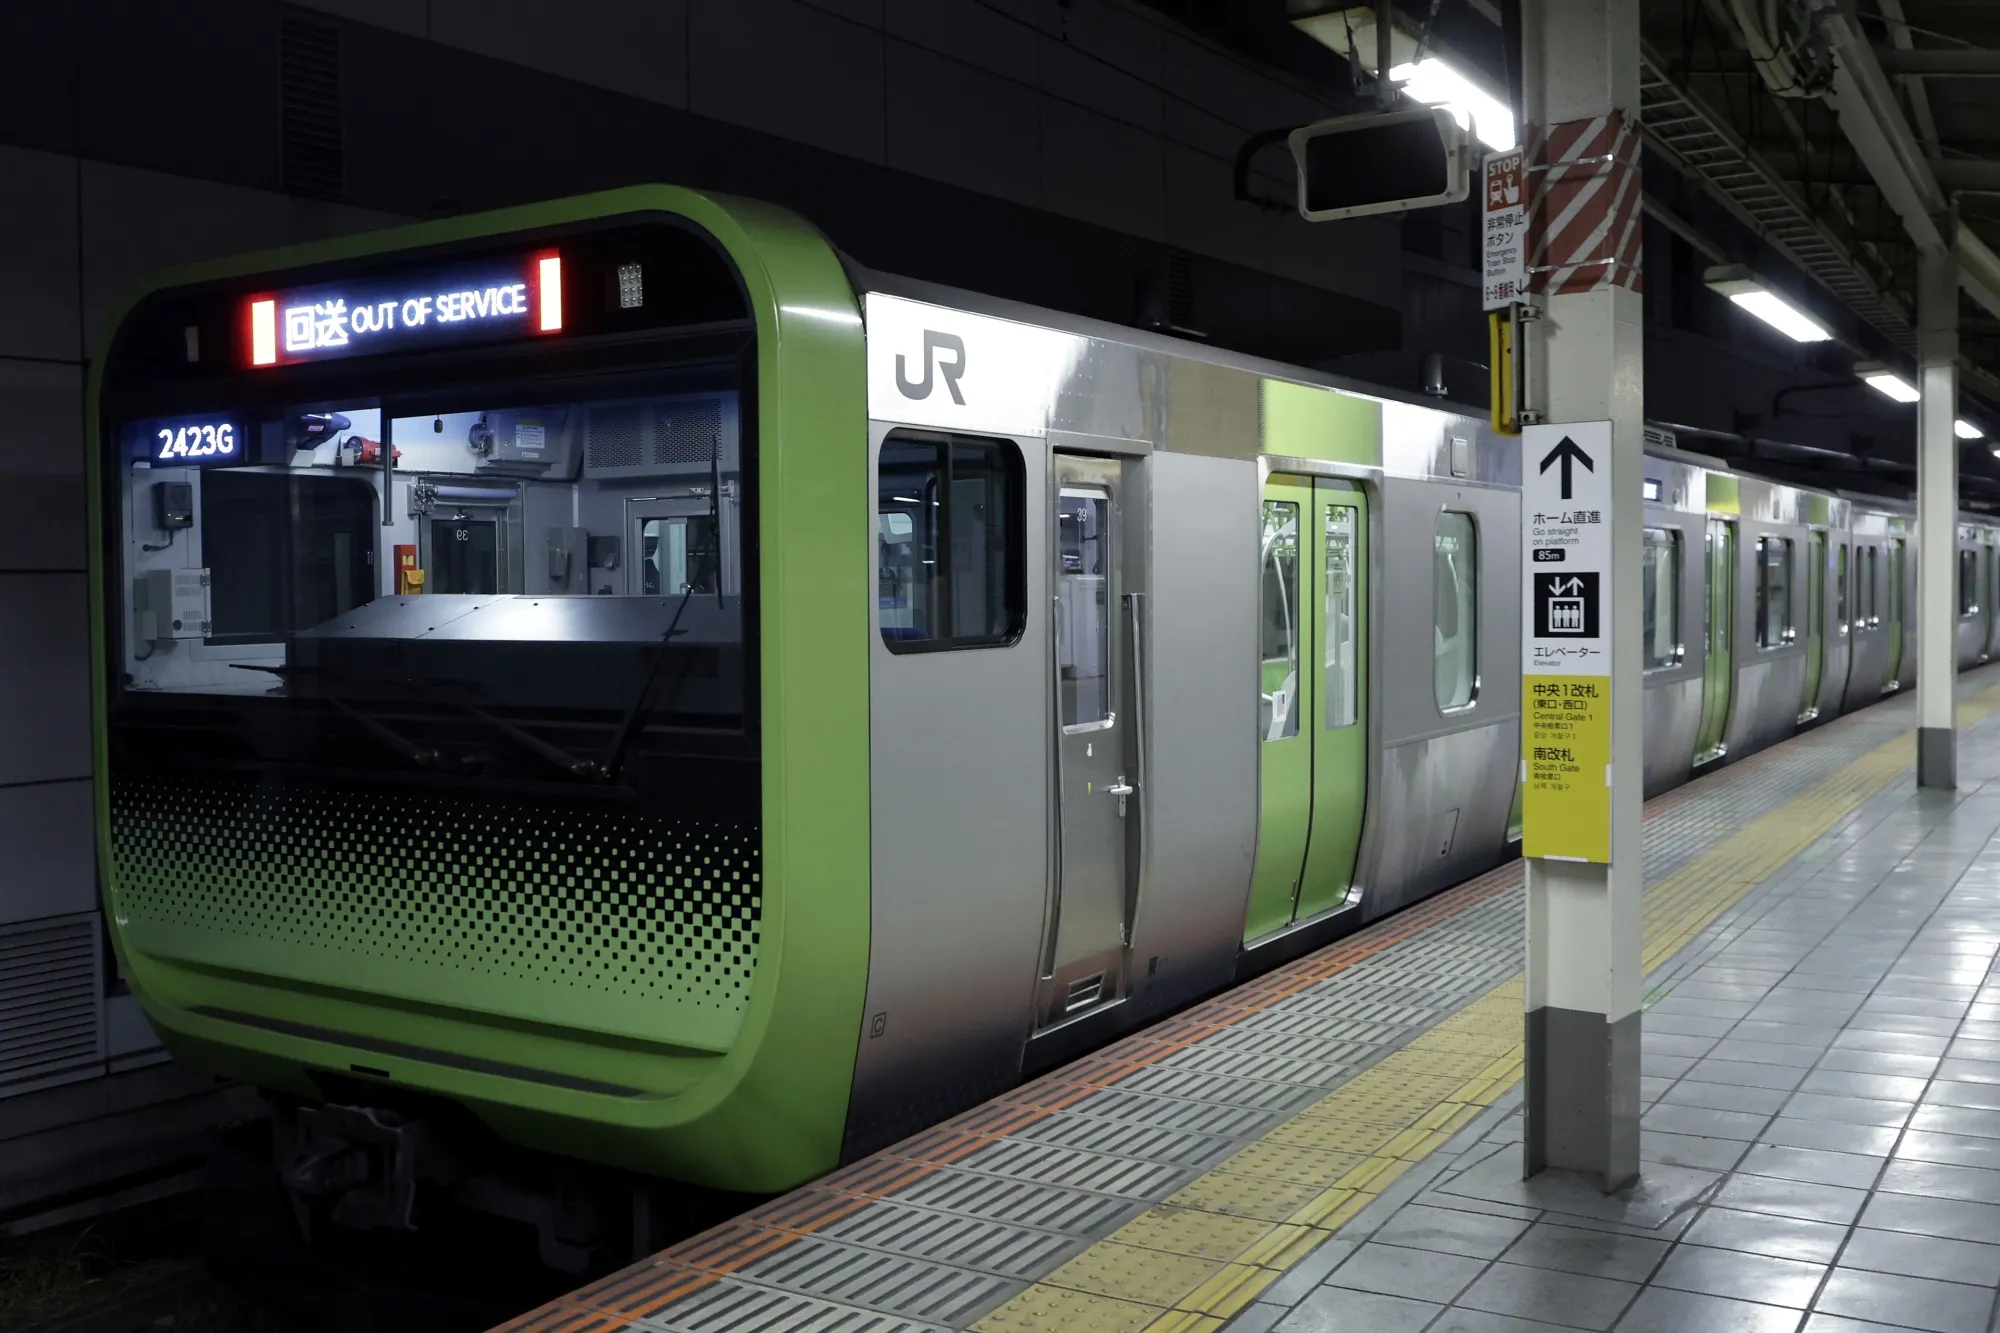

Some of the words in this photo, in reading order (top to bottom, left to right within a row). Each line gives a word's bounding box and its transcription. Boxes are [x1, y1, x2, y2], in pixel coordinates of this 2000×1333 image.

[1488, 156, 1521, 177] STOP
[1487, 212, 1524, 232] 非常停止
[1486, 232, 1514, 247] ボタン
[286, 299, 349, 351] 回送
[351, 301, 399, 333] OUT
[402, 297, 433, 327] OF
[436, 284, 527, 322] SERVICE
[895, 328, 966, 406] JR
[158, 423, 234, 459] 2423G
[1076, 508, 1087, 521] 39
[1533, 510, 1601, 525] ホーム直進
[1532, 527, 1546, 536] Go
[1547, 527, 1579, 537] straight
[1545, 537, 1579, 547] platform
[1538, 550, 1560, 560] 85m
[1533, 646, 1601, 658] エレベーター
[1533, 659, 1561, 667] Elevator
[1533, 683, 1599, 698] 中央1改札
[1533, 711, 1563, 720] Central
[1565, 712, 1586, 721] Gate
[1533, 747, 1575, 762] 南改札
[1533, 762, 1558, 771] South
[1559, 763, 1580, 773] Gate
